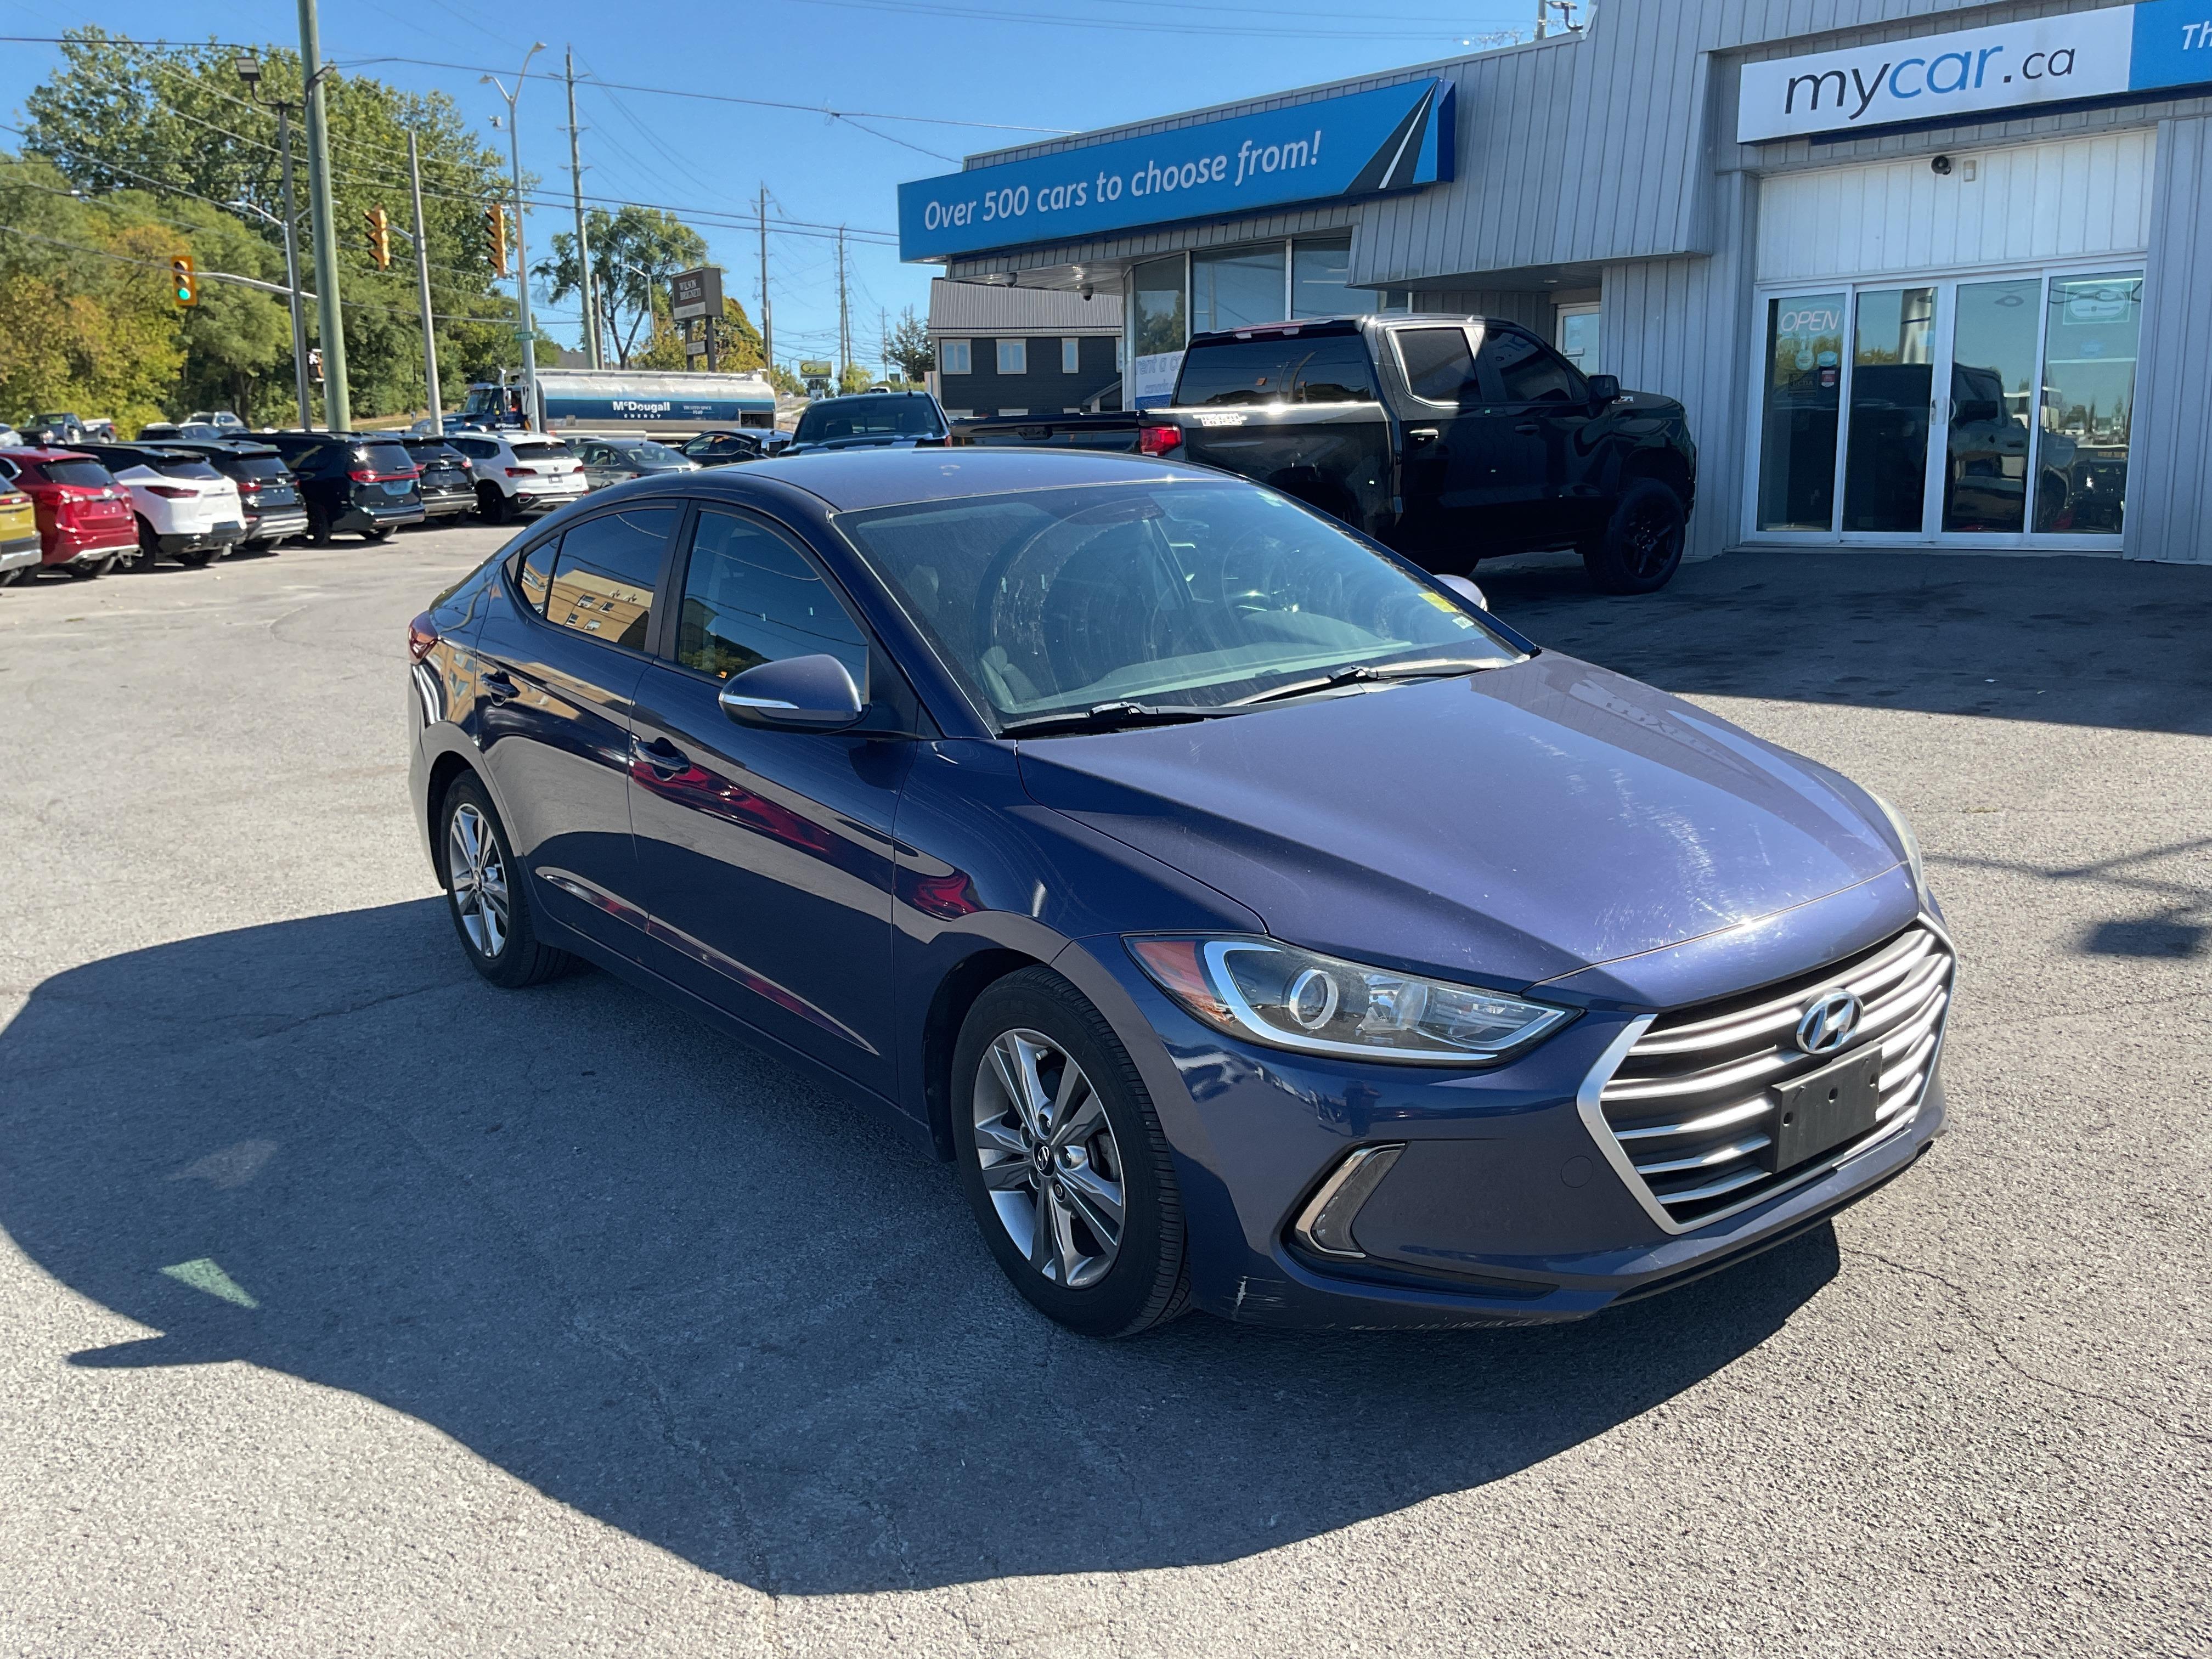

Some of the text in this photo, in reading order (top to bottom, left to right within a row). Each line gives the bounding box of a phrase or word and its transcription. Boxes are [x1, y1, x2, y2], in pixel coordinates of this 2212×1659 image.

[925, 130, 1322, 231] Over 500 cars to choose from!
[1781, 311, 1840, 332] OPEN
[1159, 357, 1167, 373] a
[612, 401, 670, 413] McDougall
